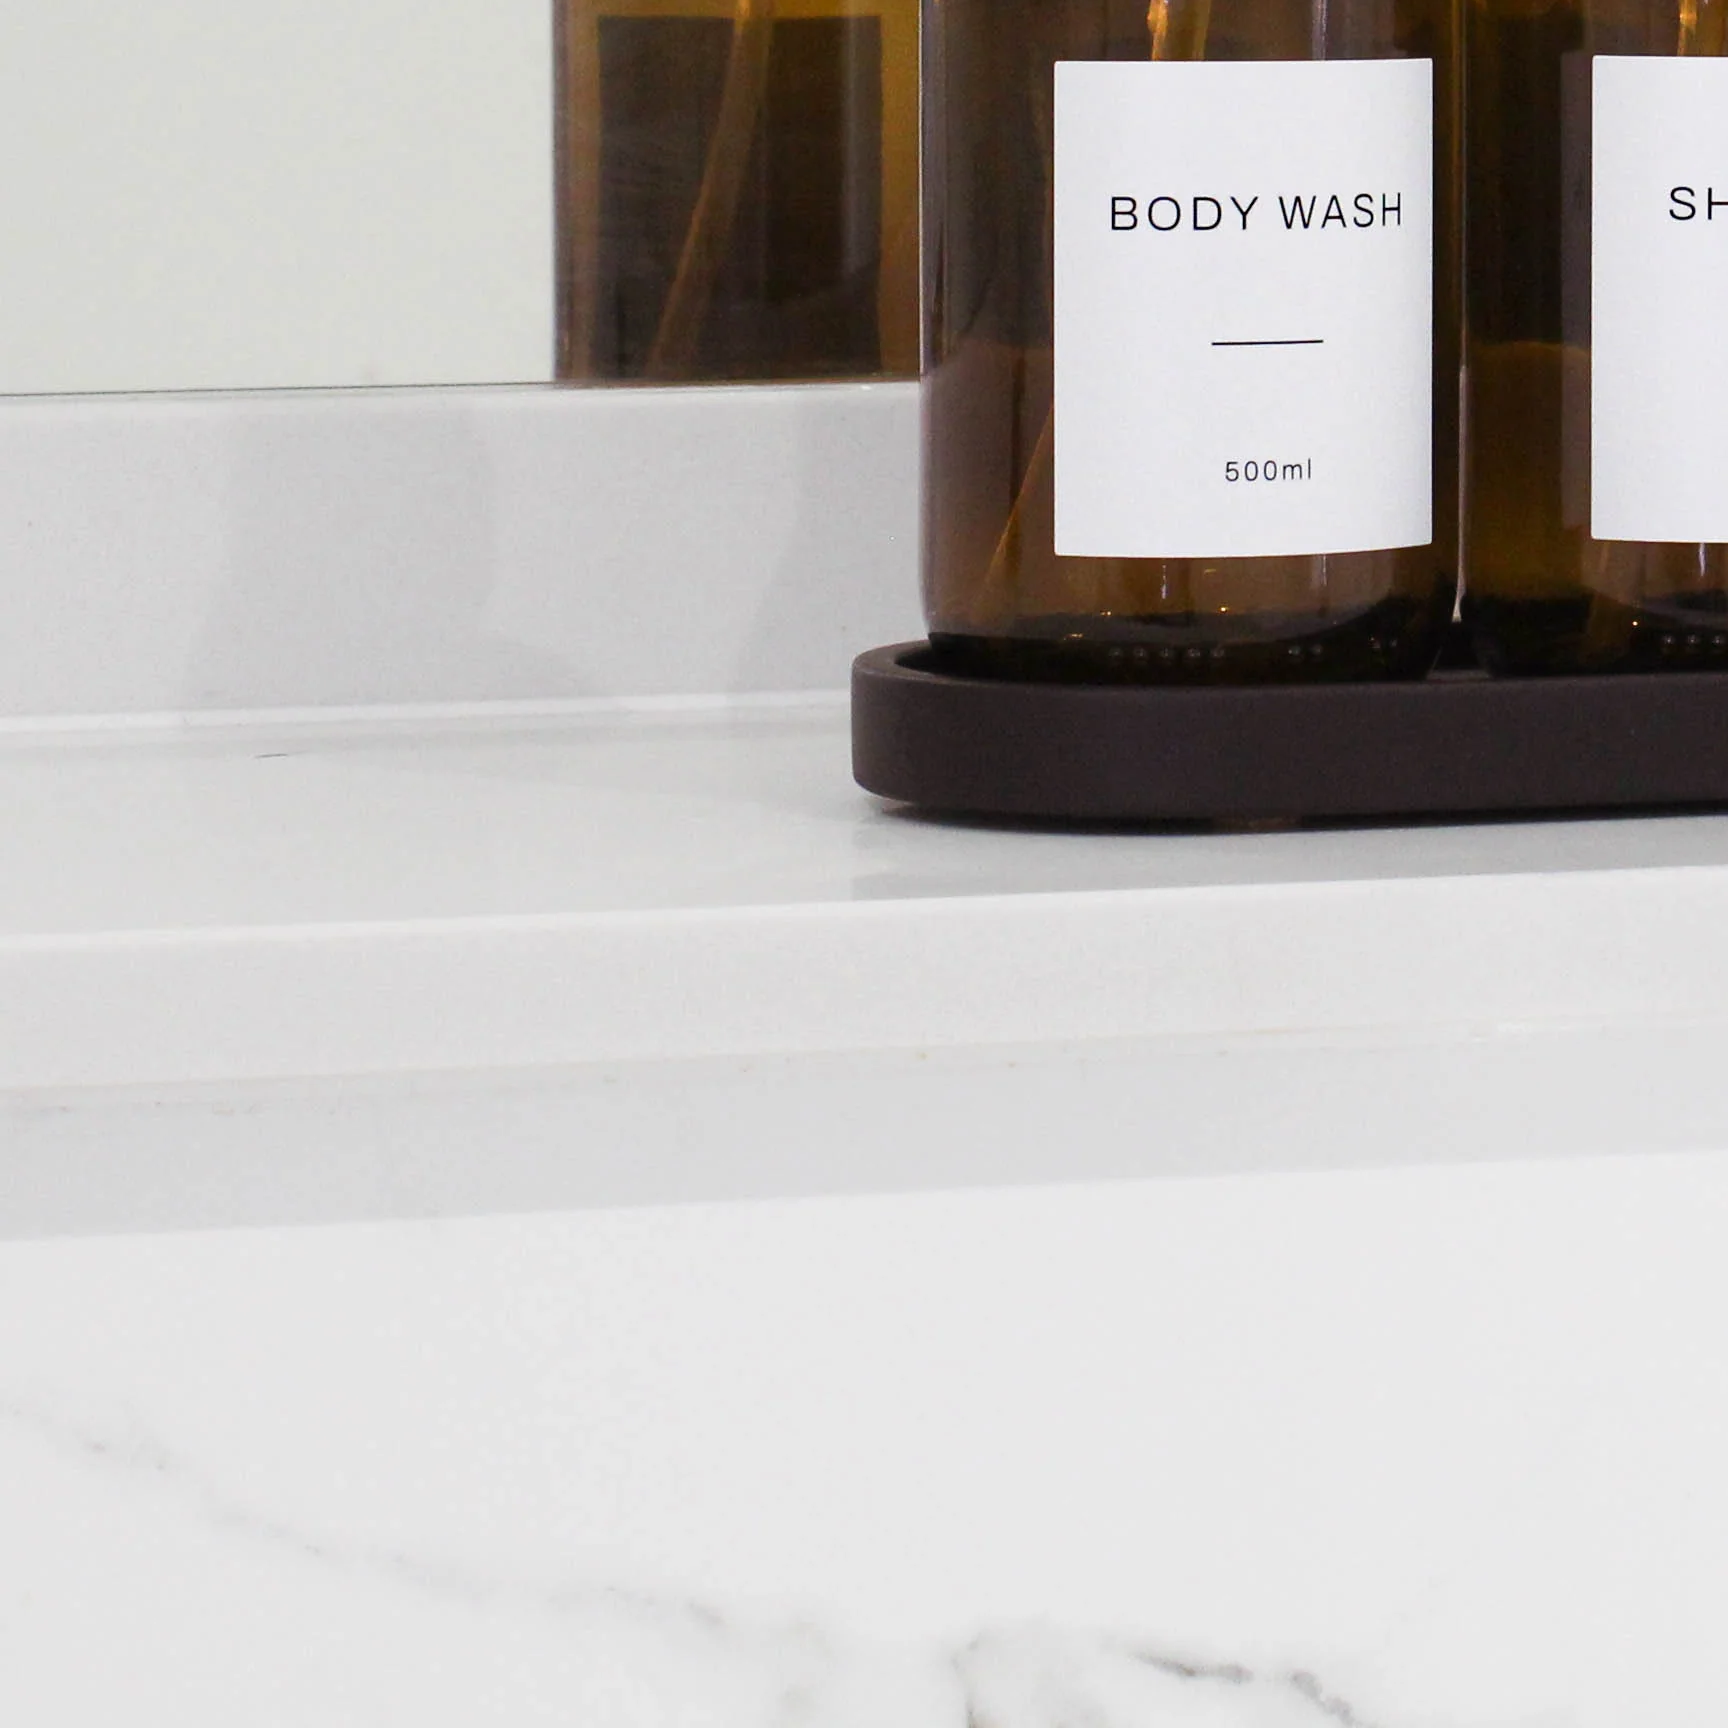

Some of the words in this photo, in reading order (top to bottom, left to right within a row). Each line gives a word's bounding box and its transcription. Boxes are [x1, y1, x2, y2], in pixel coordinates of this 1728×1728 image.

[1110, 195, 1260, 232] BODY
[1277, 192, 1402, 230] WASH
[1225, 458, 1312, 482] 500ml
